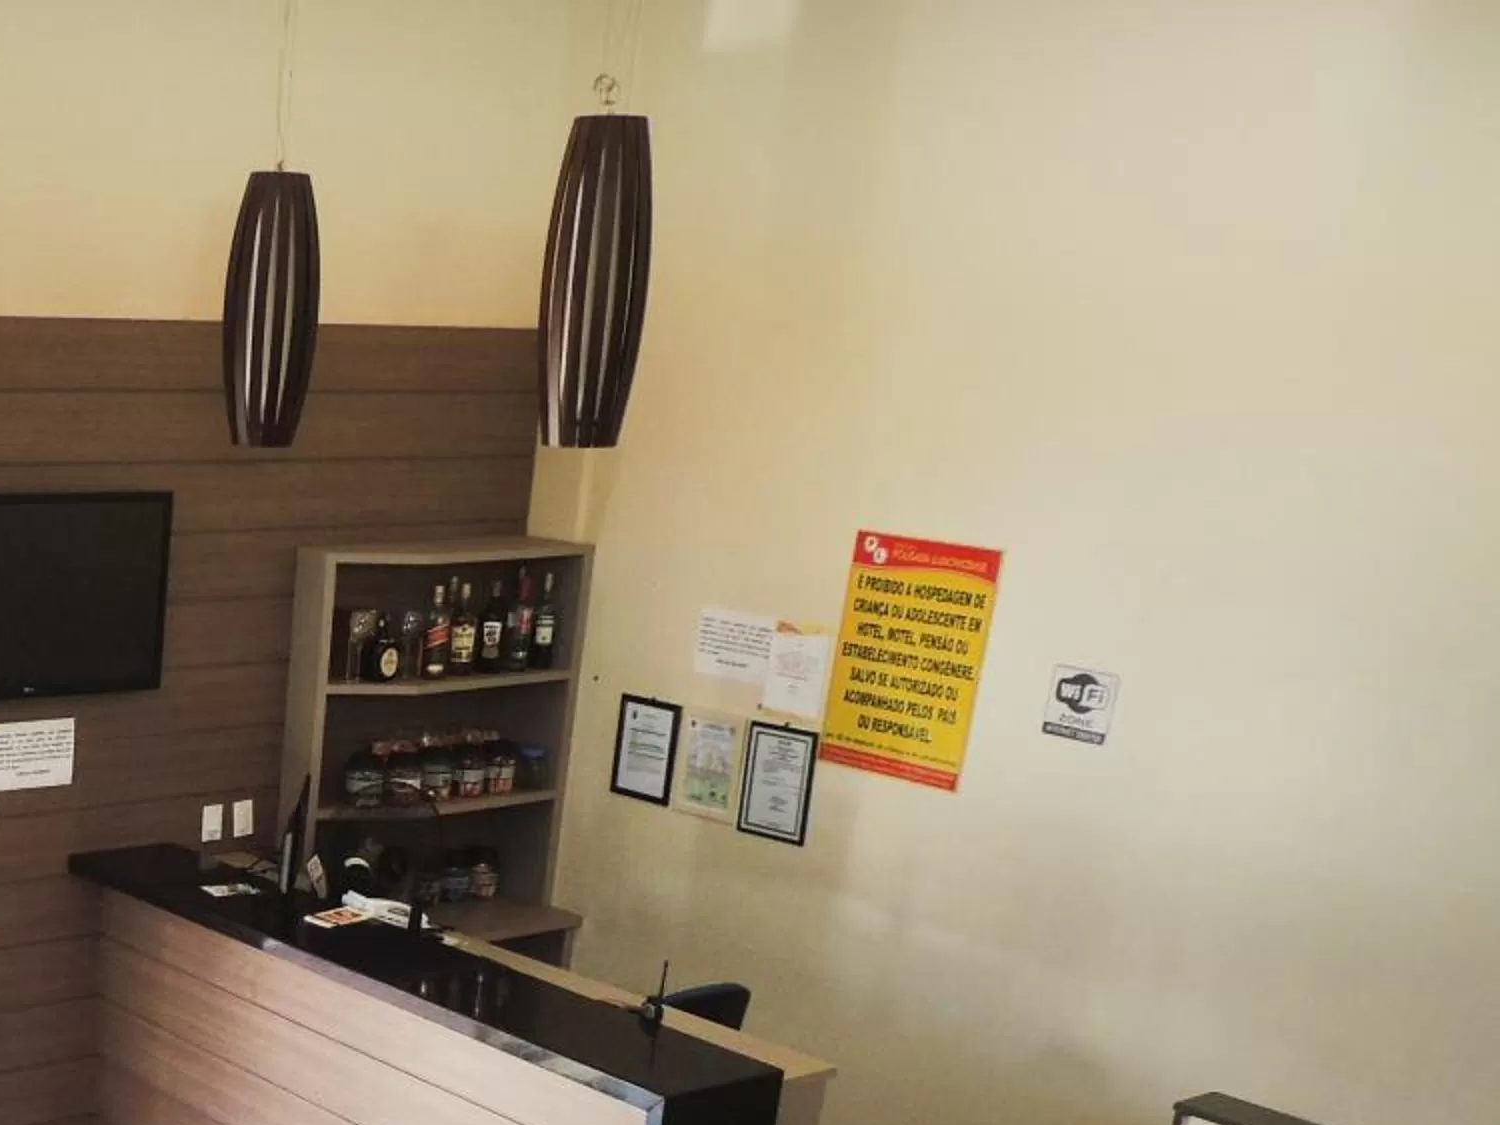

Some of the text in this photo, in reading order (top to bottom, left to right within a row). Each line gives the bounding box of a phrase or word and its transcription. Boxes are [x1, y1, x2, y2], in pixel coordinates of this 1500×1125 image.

[865, 576, 904, 594] PROIBIDO
[913, 584, 972, 606] HOSPEDAGEM
[853, 598, 889, 618] CRIANÇA
[905, 607, 966, 630] ADOLESCENTE
[842, 641, 918, 669] ESTABELECIMENTO
[850, 667, 875, 683] SALVO
[890, 675, 943, 698] AUTORIZADO
[843, 688, 956, 725] ACOMPANHADO PELOS PAIS
